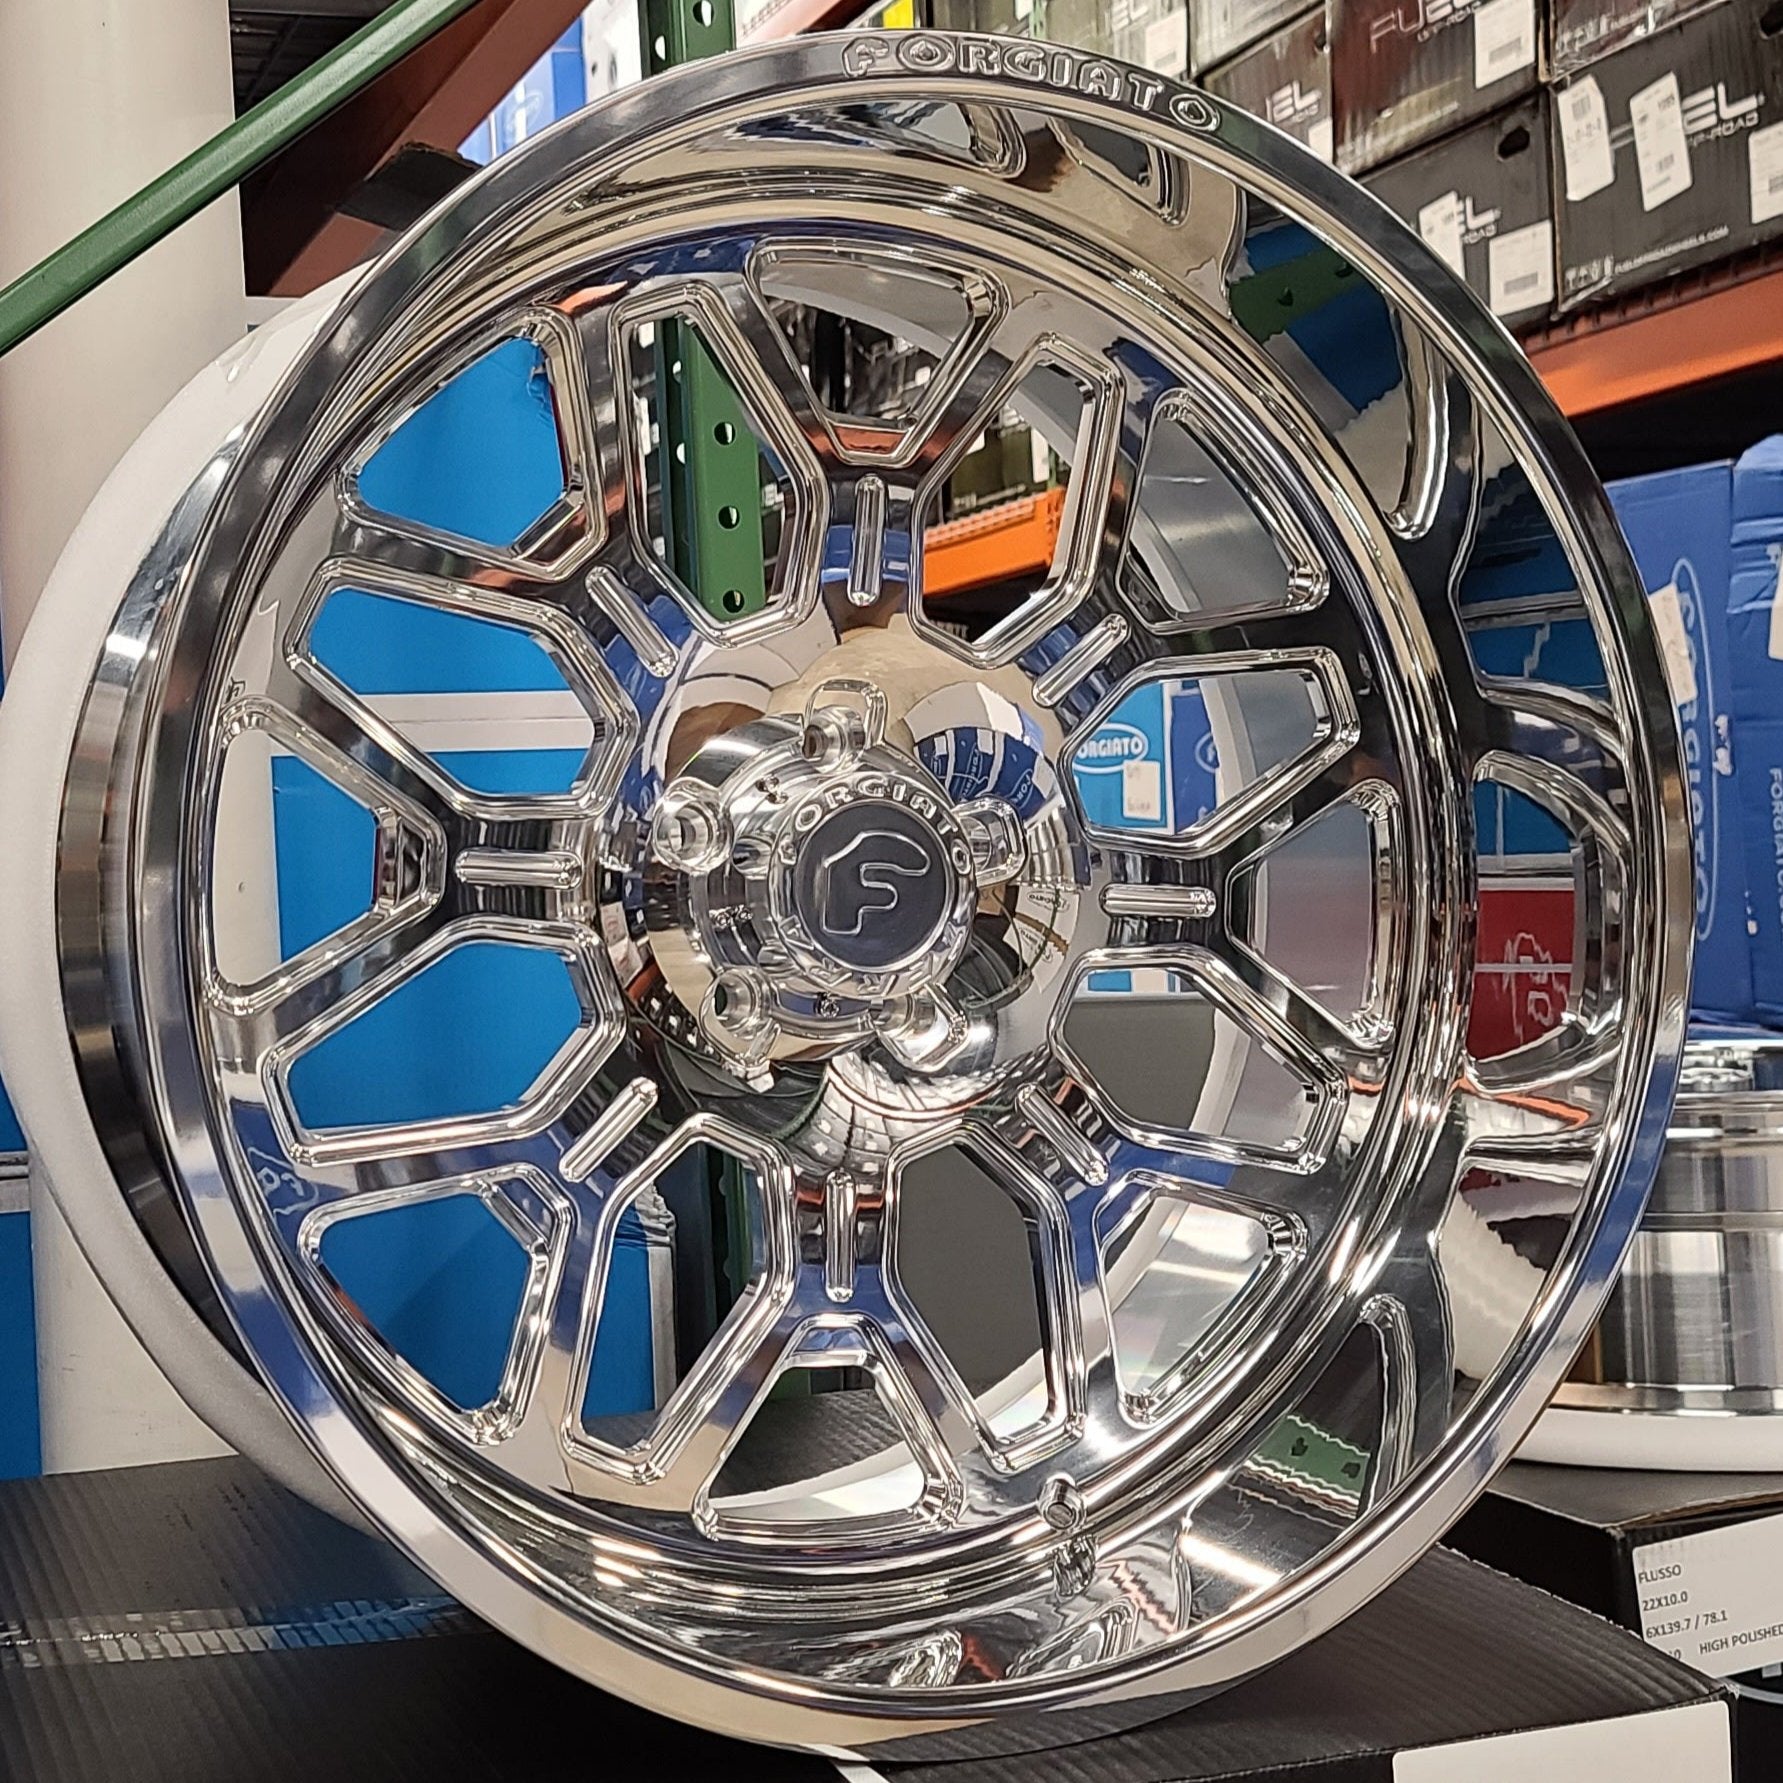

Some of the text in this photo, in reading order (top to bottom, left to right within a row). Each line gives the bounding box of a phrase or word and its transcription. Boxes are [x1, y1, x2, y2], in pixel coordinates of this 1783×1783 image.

[1370, 0, 1476, 54] FUE
[842, 33, 1221, 132] FORGIATO
[1681, 82, 1758, 135] EL
[1077, 737, 1143, 759] ORGIATO
[778, 775, 970, 876] FORGIATO
[1639, 1564, 1682, 1583] FLUSSO
[1643, 1591, 1688, 1611] 22X10.0
[1646, 1618, 1691, 1639] 6X139.7
[1703, 1610, 1728, 1626] 78.1
[1699, 1638, 1729, 1655] HIGH
